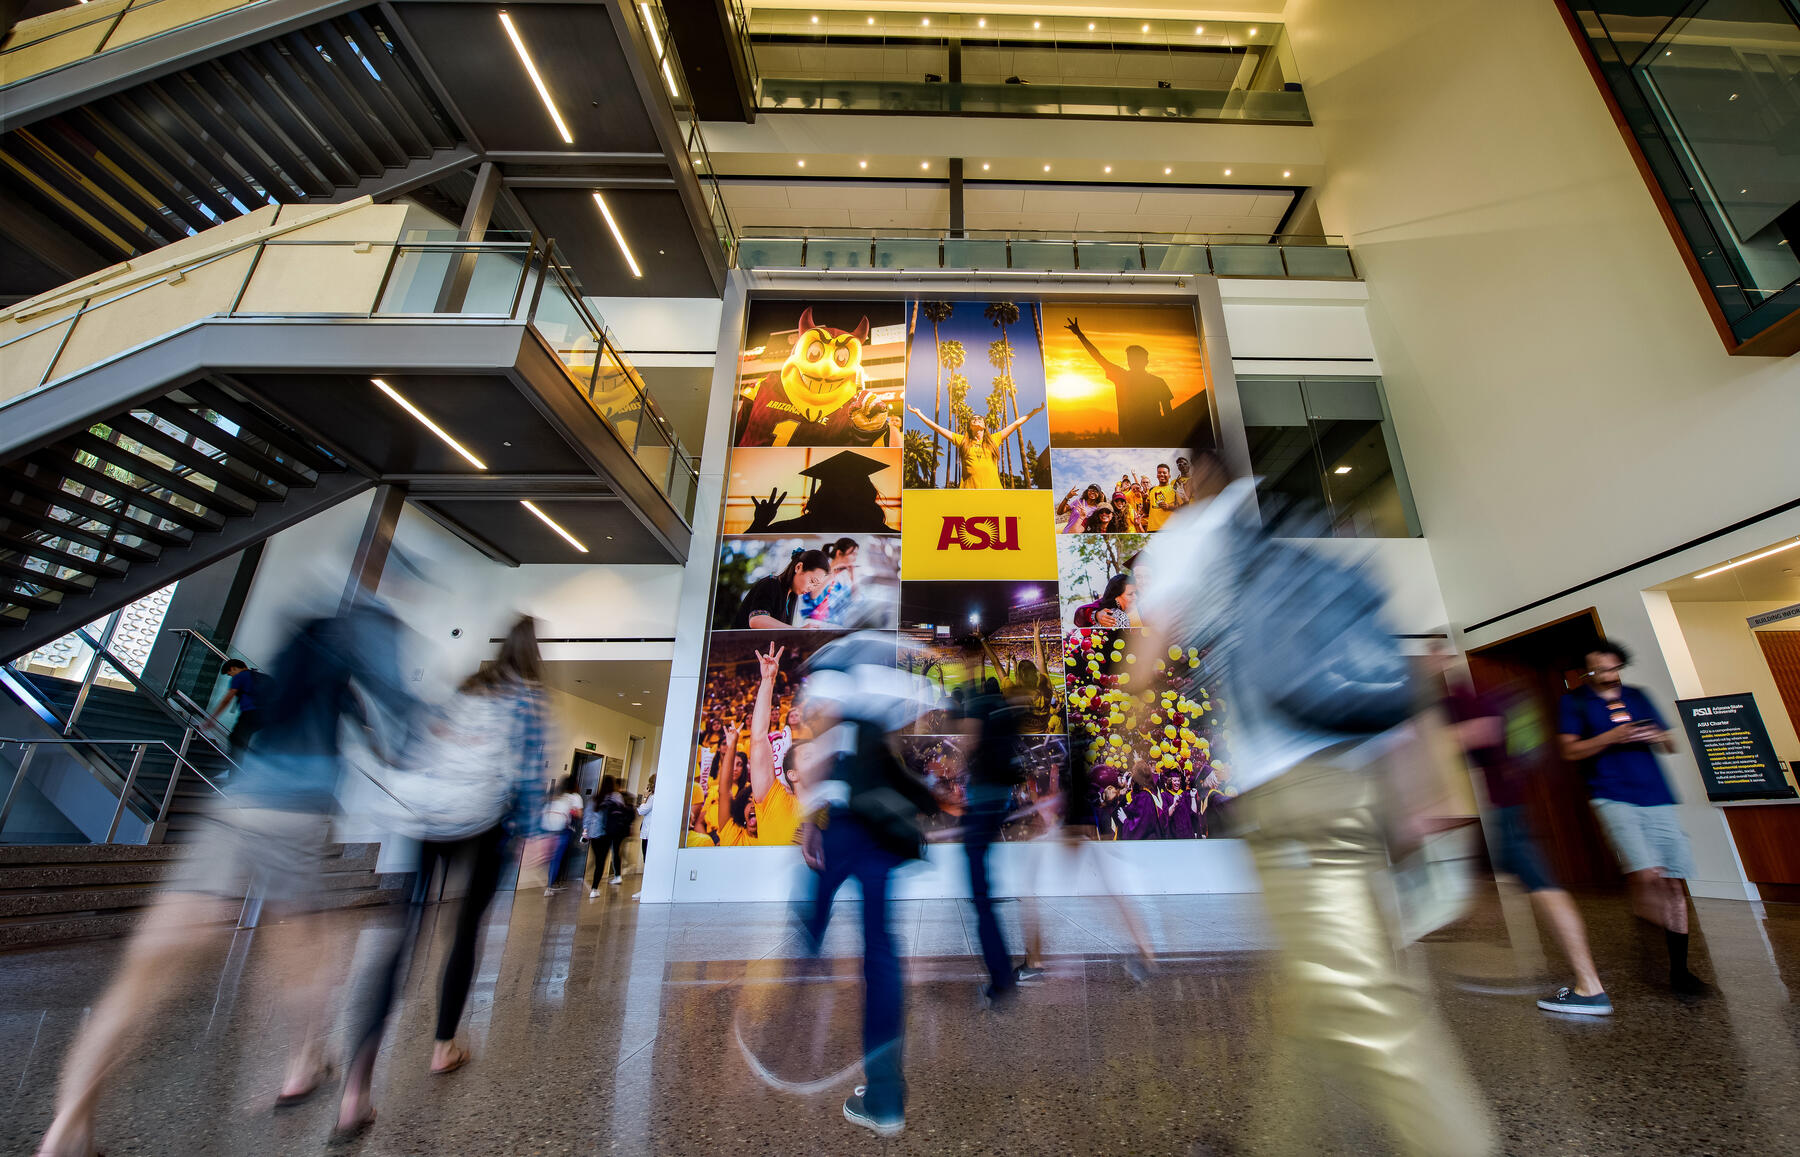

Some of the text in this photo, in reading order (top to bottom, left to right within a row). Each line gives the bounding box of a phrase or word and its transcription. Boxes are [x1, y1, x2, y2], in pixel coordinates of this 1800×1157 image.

[936, 516, 1021, 551] ASU
[1754, 614, 1782, 624] BUILDING
[1693, 707, 1713, 716] ASU
